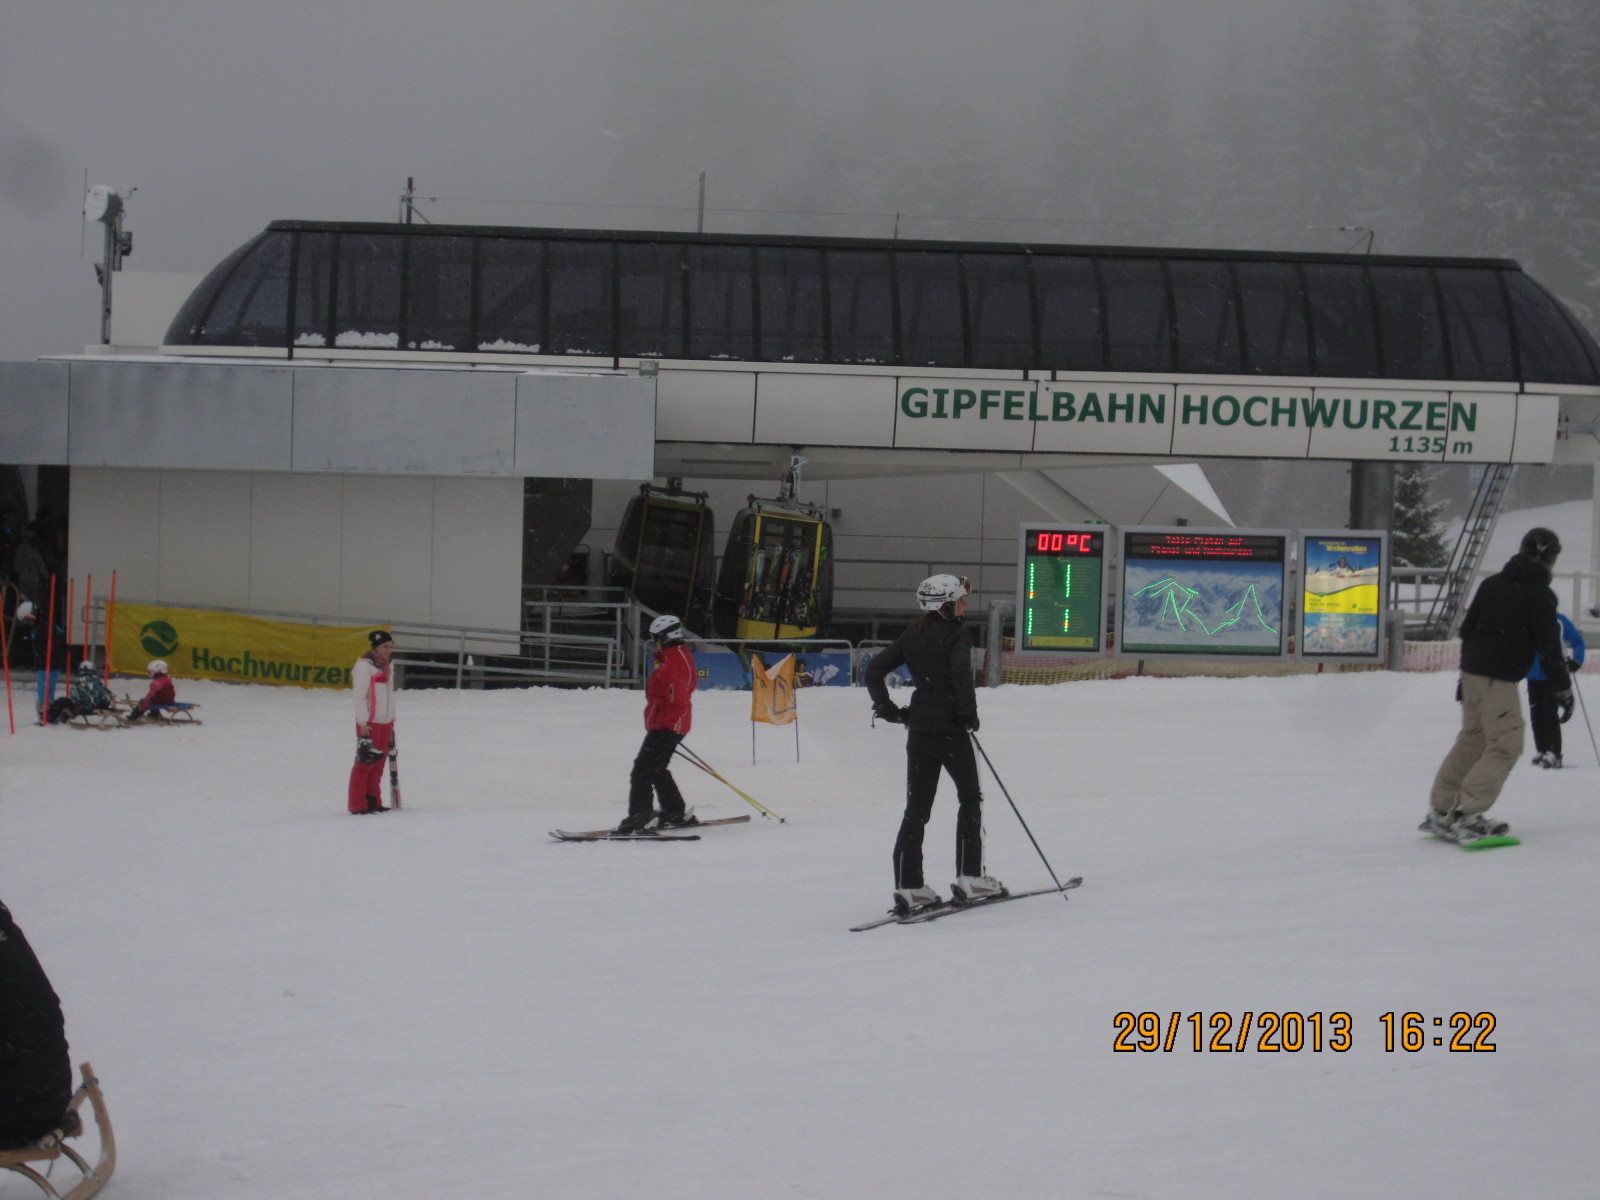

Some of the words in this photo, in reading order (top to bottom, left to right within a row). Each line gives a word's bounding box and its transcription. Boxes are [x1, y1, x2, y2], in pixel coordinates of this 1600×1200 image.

[901, 387, 1166, 424] GIPFELBAHN
[1181, 394, 1477, 432] HOCHWURZEN
[1387, 435, 1446, 455] 1135
[1453, 440, 1473, 455] m
